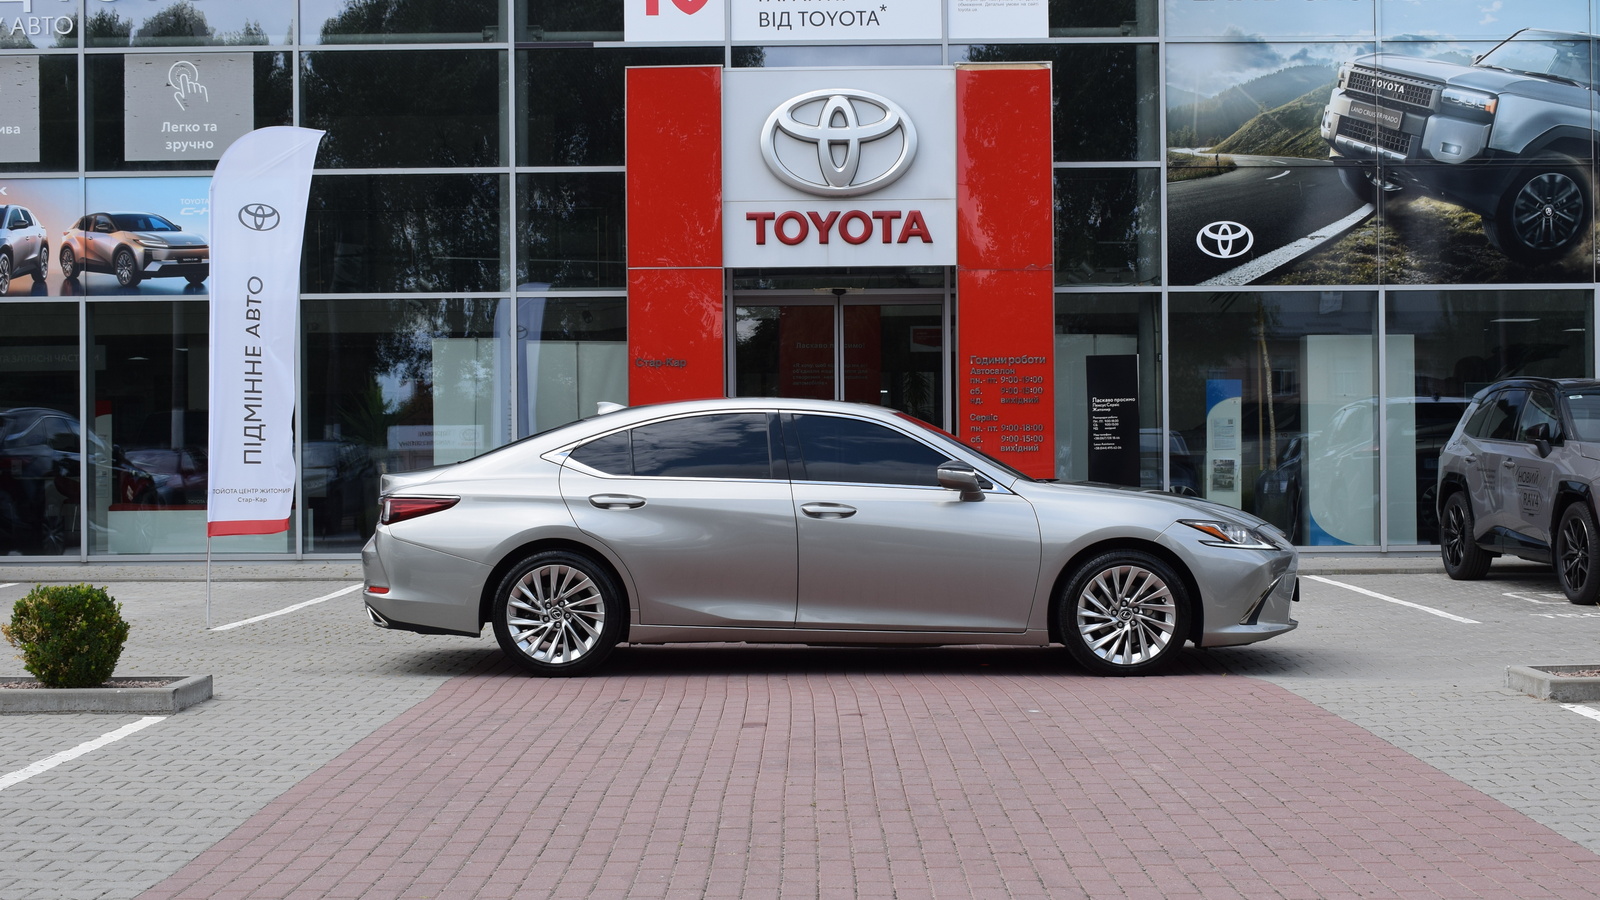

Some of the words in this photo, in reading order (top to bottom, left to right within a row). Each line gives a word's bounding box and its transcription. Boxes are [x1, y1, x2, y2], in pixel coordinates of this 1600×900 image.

[10, 16, 73, 35] АВТО
[759, 12, 792, 30] ВІД
[1371, 79, 1404, 93] TOYOTA
[1351, 106, 1363, 114] LAND
[161, 122, 200, 133] Легко
[203, 123, 218, 132] та
[165, 140, 214, 153] зручно
[746, 210, 933, 245] TOYOTA
[246, 276, 263, 339] АВТО
[635, 358, 687, 369] Стар-Кар
[969, 355, 1007, 366] Години
[1008, 354, 1046, 366] роботи
[969, 367, 1016, 375] Автосалон
[970, 387, 983, 395] сб.
[244, 345, 266, 464] ПІДМІННЕ
[1000, 396, 1040, 404] вихідний
[969, 413, 998, 423] Сервіс
[970, 435, 983, 443] сб.
[1000, 444, 1039, 452] вихідний
[1517, 470, 1539, 485] НОВИЙ
[1523, 492, 1539, 507] RAV4
